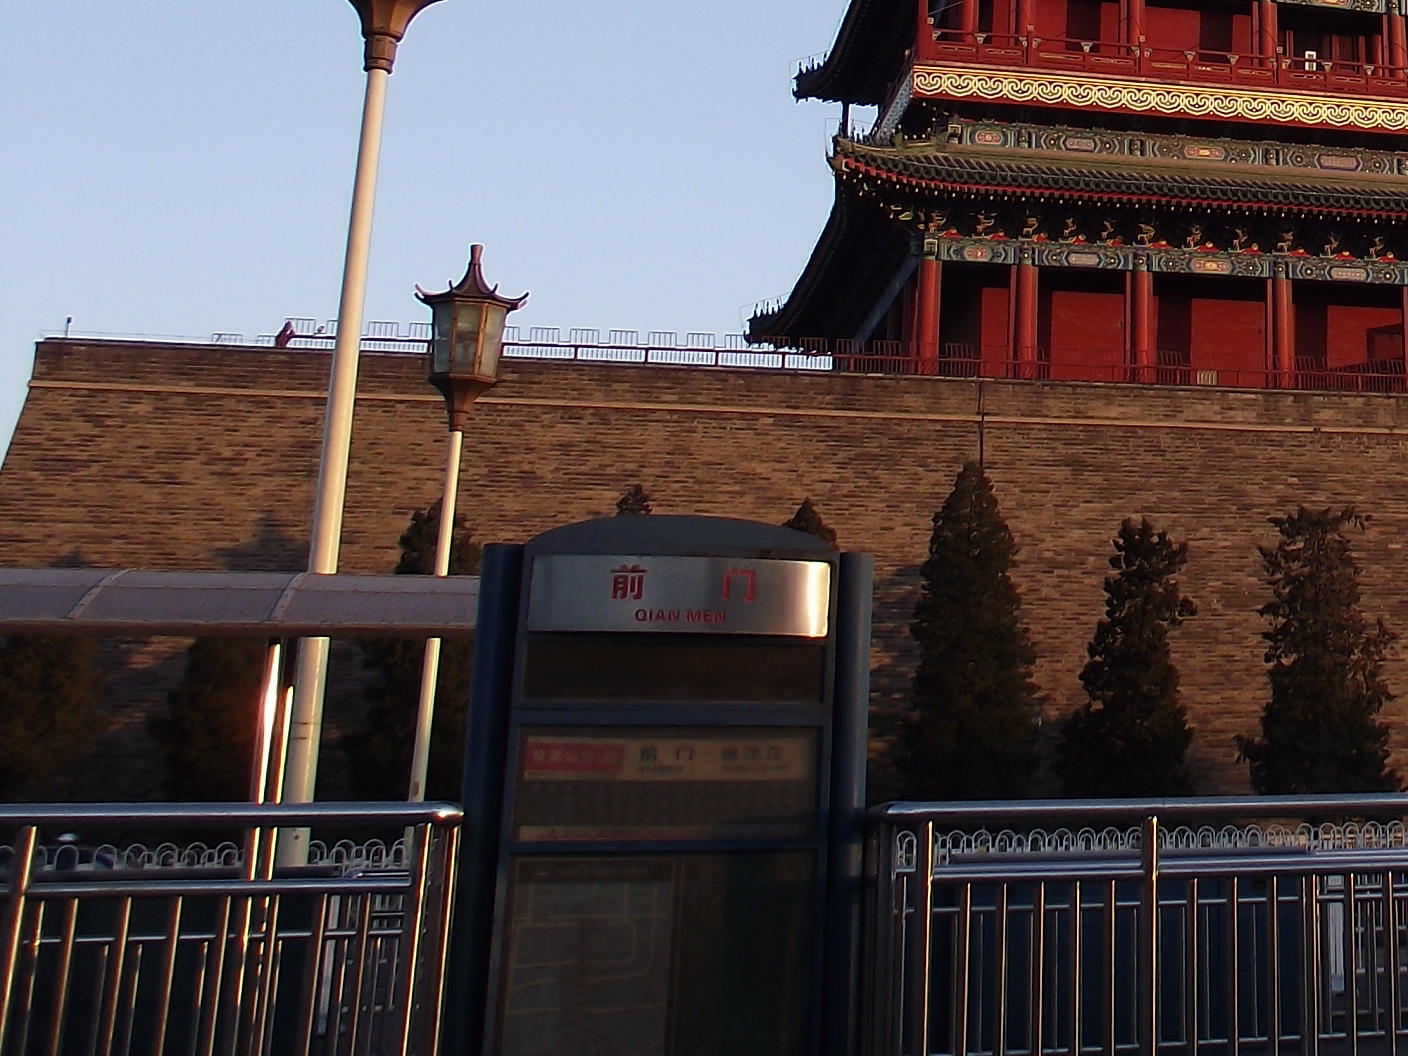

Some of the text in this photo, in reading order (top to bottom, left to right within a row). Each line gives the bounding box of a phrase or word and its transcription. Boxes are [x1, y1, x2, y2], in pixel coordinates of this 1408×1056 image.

[610, 564, 757, 602] 前门
[634, 608, 726, 623] QIAN MEN
